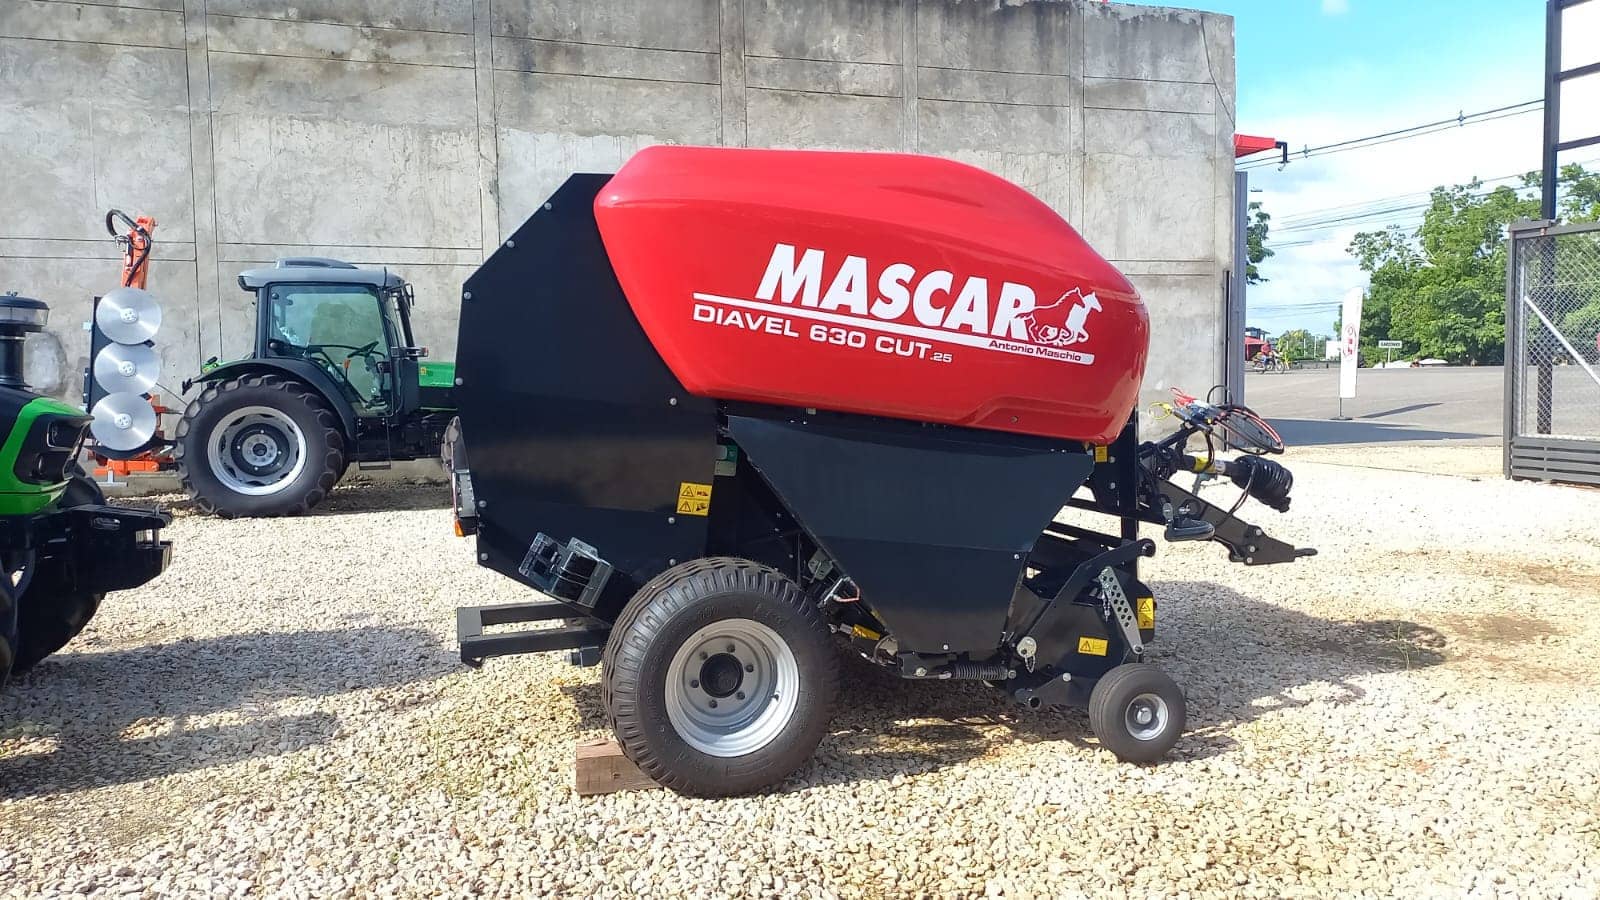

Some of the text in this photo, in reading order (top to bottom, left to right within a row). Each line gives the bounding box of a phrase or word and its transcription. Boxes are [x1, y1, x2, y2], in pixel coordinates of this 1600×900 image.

[755, 243, 1036, 341] MASCAR
[693, 303, 800, 338] DIAVEL
[809, 324, 867, 349] 630
[989, 339, 1082, 362] Antonio Maschio
